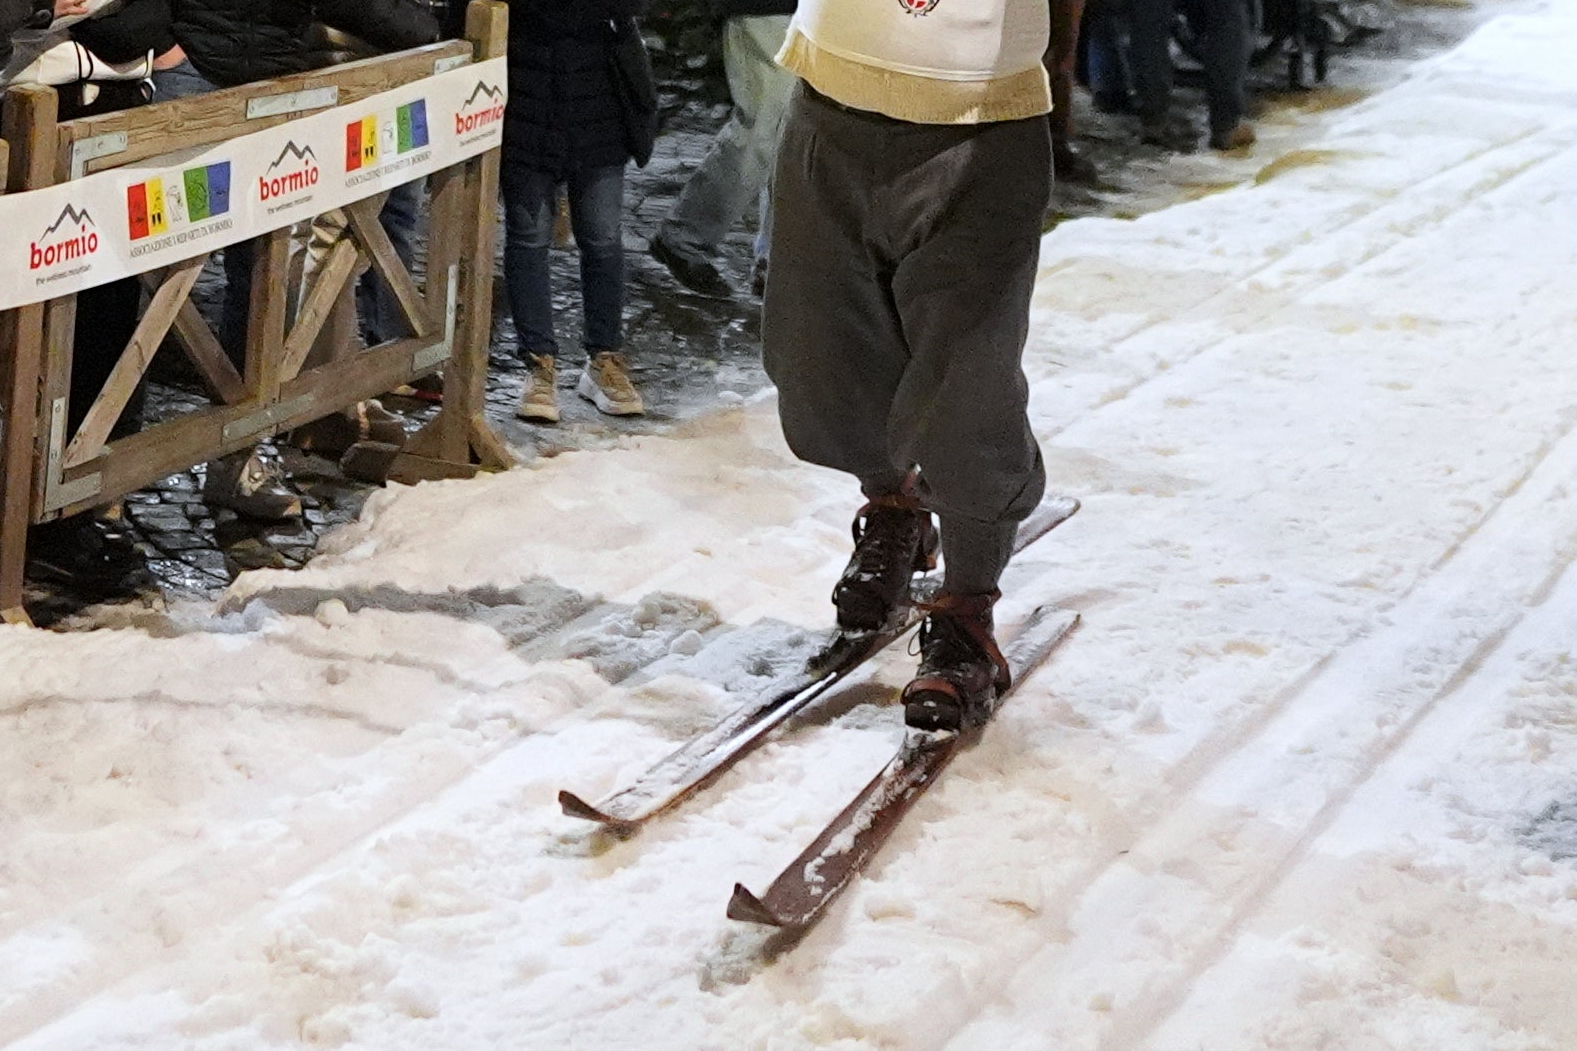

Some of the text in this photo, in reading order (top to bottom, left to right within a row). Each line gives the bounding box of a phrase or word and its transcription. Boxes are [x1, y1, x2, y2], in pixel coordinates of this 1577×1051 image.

[456, 98, 505, 134] bormio
[259, 159, 319, 201] bormio
[30, 224, 98, 269] bormio
